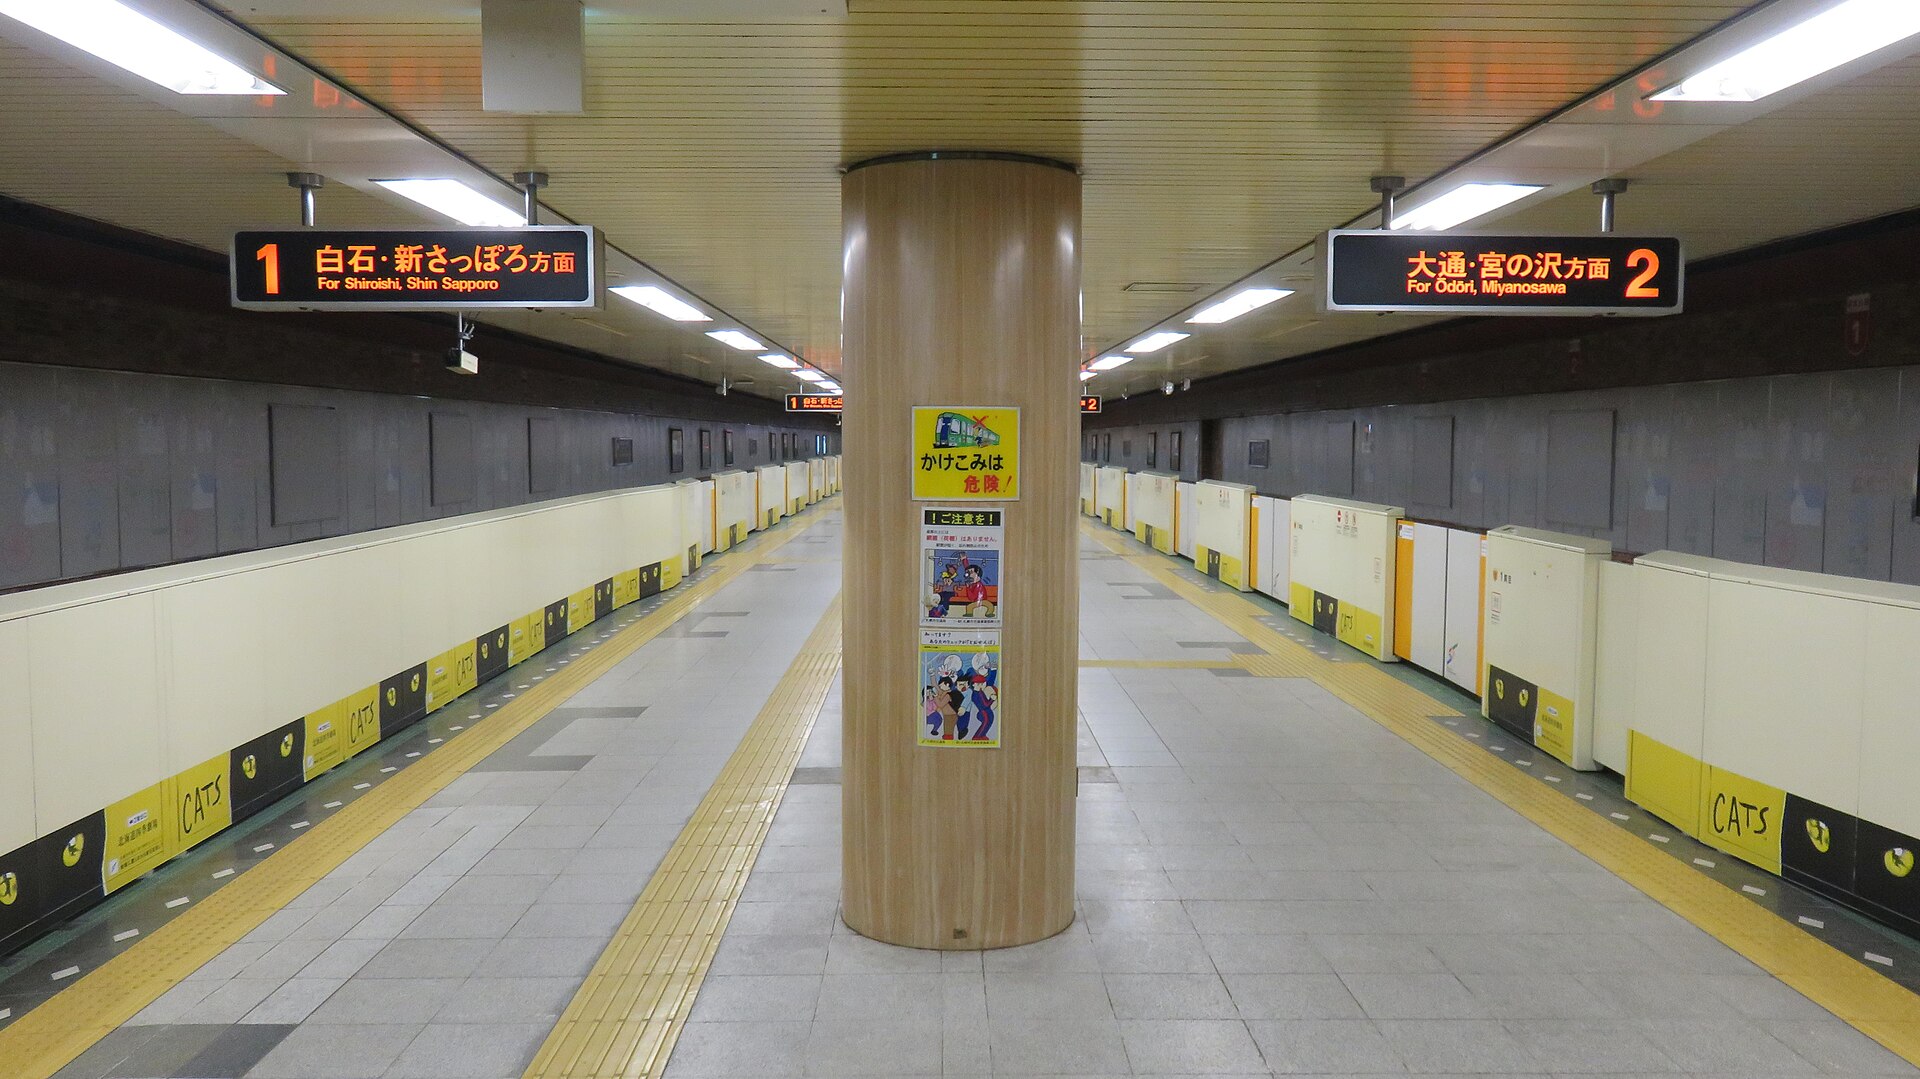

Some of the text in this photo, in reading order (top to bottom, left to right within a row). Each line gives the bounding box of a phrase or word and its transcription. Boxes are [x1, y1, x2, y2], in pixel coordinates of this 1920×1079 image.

[256, 243, 279, 295] 1
[315, 244, 576, 274] 白石・新さっぽろ方面
[1407, 250, 1611, 280] 大通・宮の沢方面
[1624, 248, 1660, 298] 2
[317, 276, 499, 292] For Shiroishi, Shin Sapporo
[1407, 277, 1567, 296] For Ōdōri, Miyanosawa
[791, 397, 797, 409] 1
[1088, 398, 1097, 410] 2
[920, 453, 1004, 471] かけこみは
[963, 475, 1012, 493] 危険！
[932, 513, 993, 525] ！ご注意を！
[456, 652, 474, 686] CATS
[350, 700, 374, 744] CATS
[182, 773, 222, 834] CATS
[1713, 792, 1769, 837] CATS
